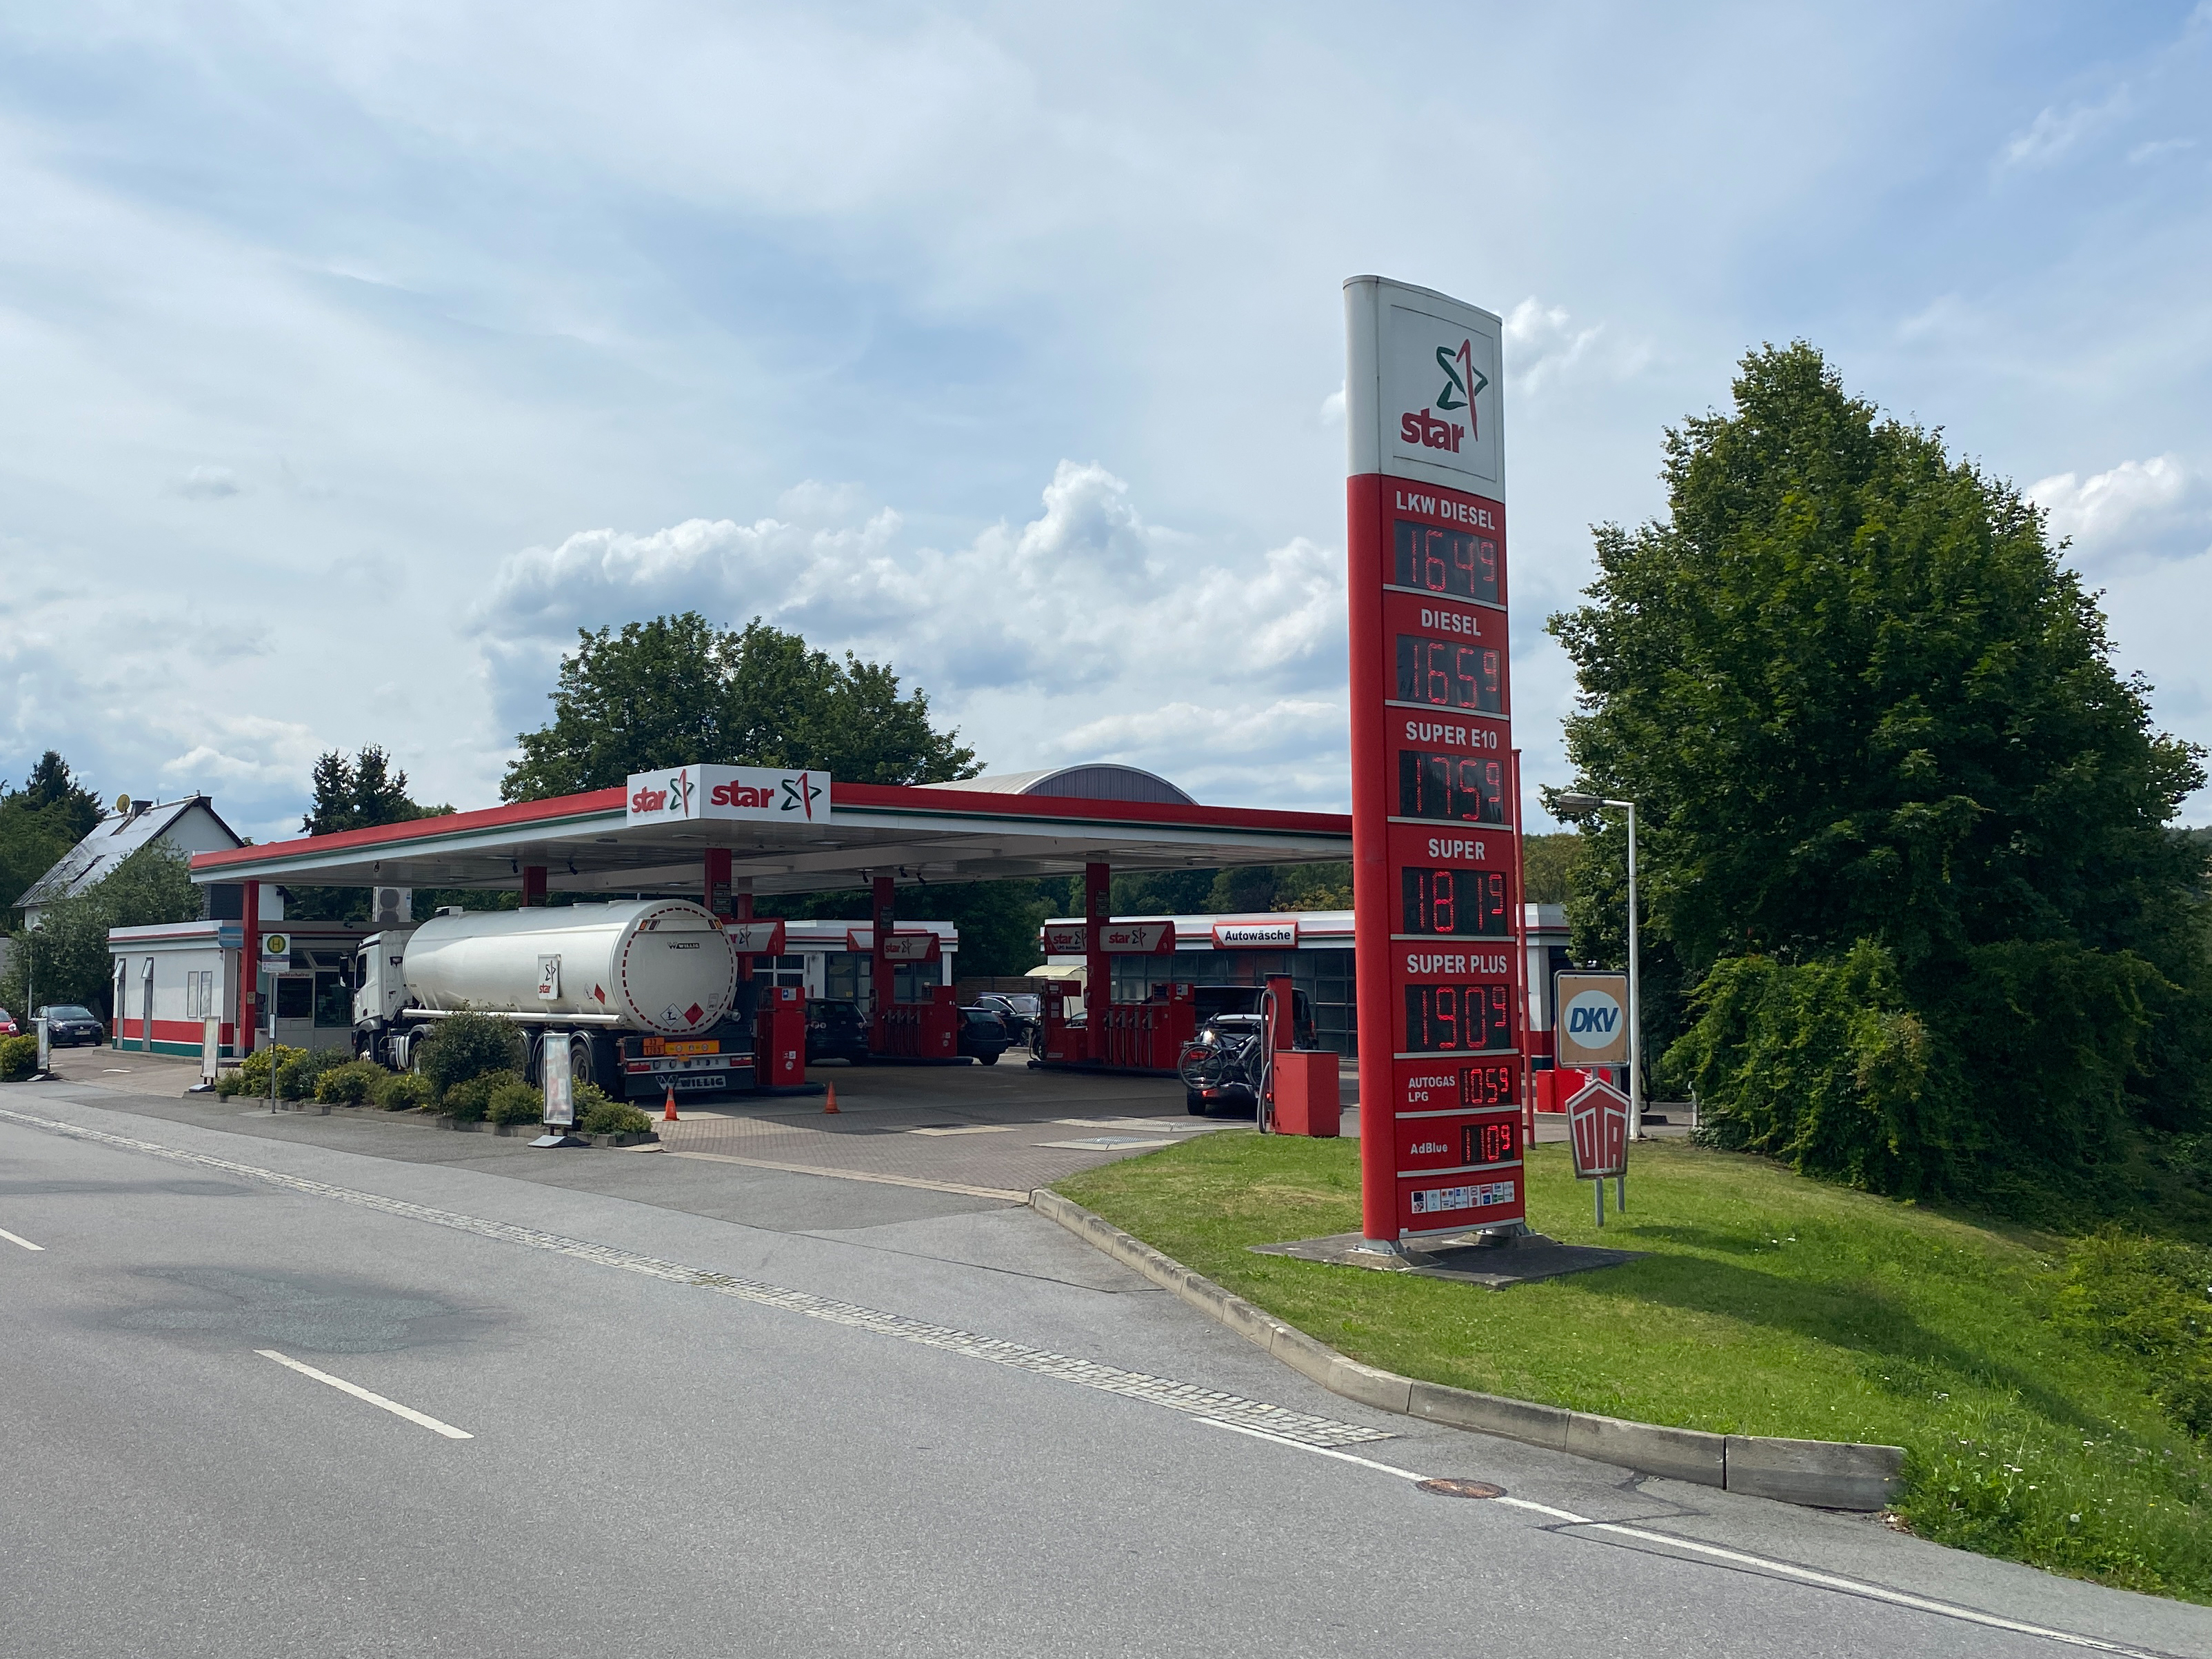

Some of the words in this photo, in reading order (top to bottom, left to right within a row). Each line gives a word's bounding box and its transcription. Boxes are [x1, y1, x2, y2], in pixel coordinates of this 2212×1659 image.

[1400, 408, 1465, 453] star
[1396, 490, 1436, 516] LKW
[1440, 501, 1496, 530] DIESEL
[1411, 529, 1495, 594] 1649
[1421, 608, 1482, 636] DIESEL
[1414, 643, 1497, 709] 1659
[1405, 721, 1467, 746] SUPER
[1471, 727, 1498, 750] E10
[632, 786, 667, 813] star
[711, 780, 774, 808] star
[1416, 757, 1500, 821] 1759
[1428, 838, 1485, 860] SUPER
[1418, 871, 1504, 932] 1819
[272, 938, 280, 950] H
[885, 943, 901, 953] star
[1053, 932, 1073, 945] star
[1108, 932, 1130, 944] star
[1225, 929, 1291, 941] Autowäsche
[1407, 954, 1466, 974] SUPER
[1470, 955, 1507, 974] PLUS
[539, 983, 551, 994] star
[1422, 986, 1506, 1049] 1909
[1569, 1007, 1619, 1033] DKV
[680, 1076, 724, 1087] WILLIG
[1408, 1076, 1456, 1089] AUTOGAS
[1463, 1067, 1509, 1103] 1059
[1408, 1092, 1429, 1103] LPG
[1410, 1142, 1449, 1155] AdBlue
